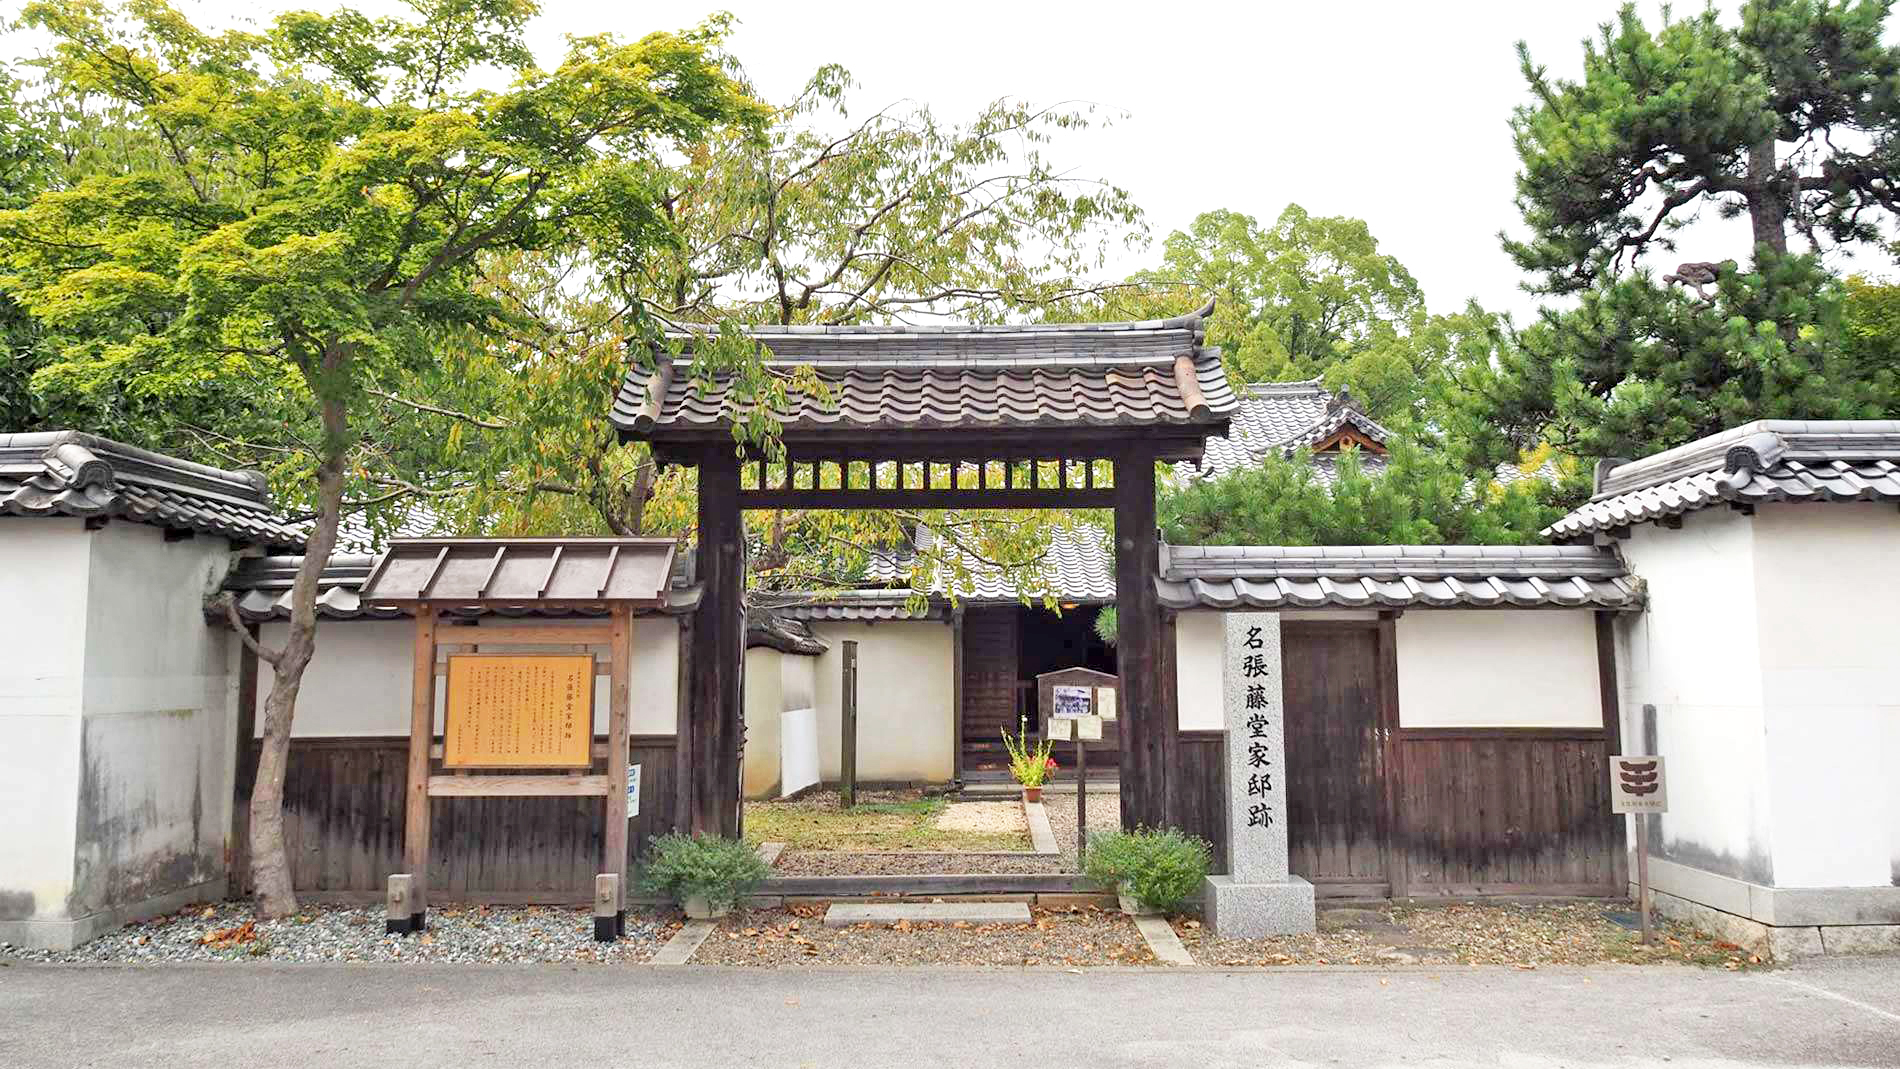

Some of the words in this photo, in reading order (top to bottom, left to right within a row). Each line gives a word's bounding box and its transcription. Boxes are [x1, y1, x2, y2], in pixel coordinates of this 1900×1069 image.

[1243, 626, 1273, 828] 名張藤堂家邸跡
